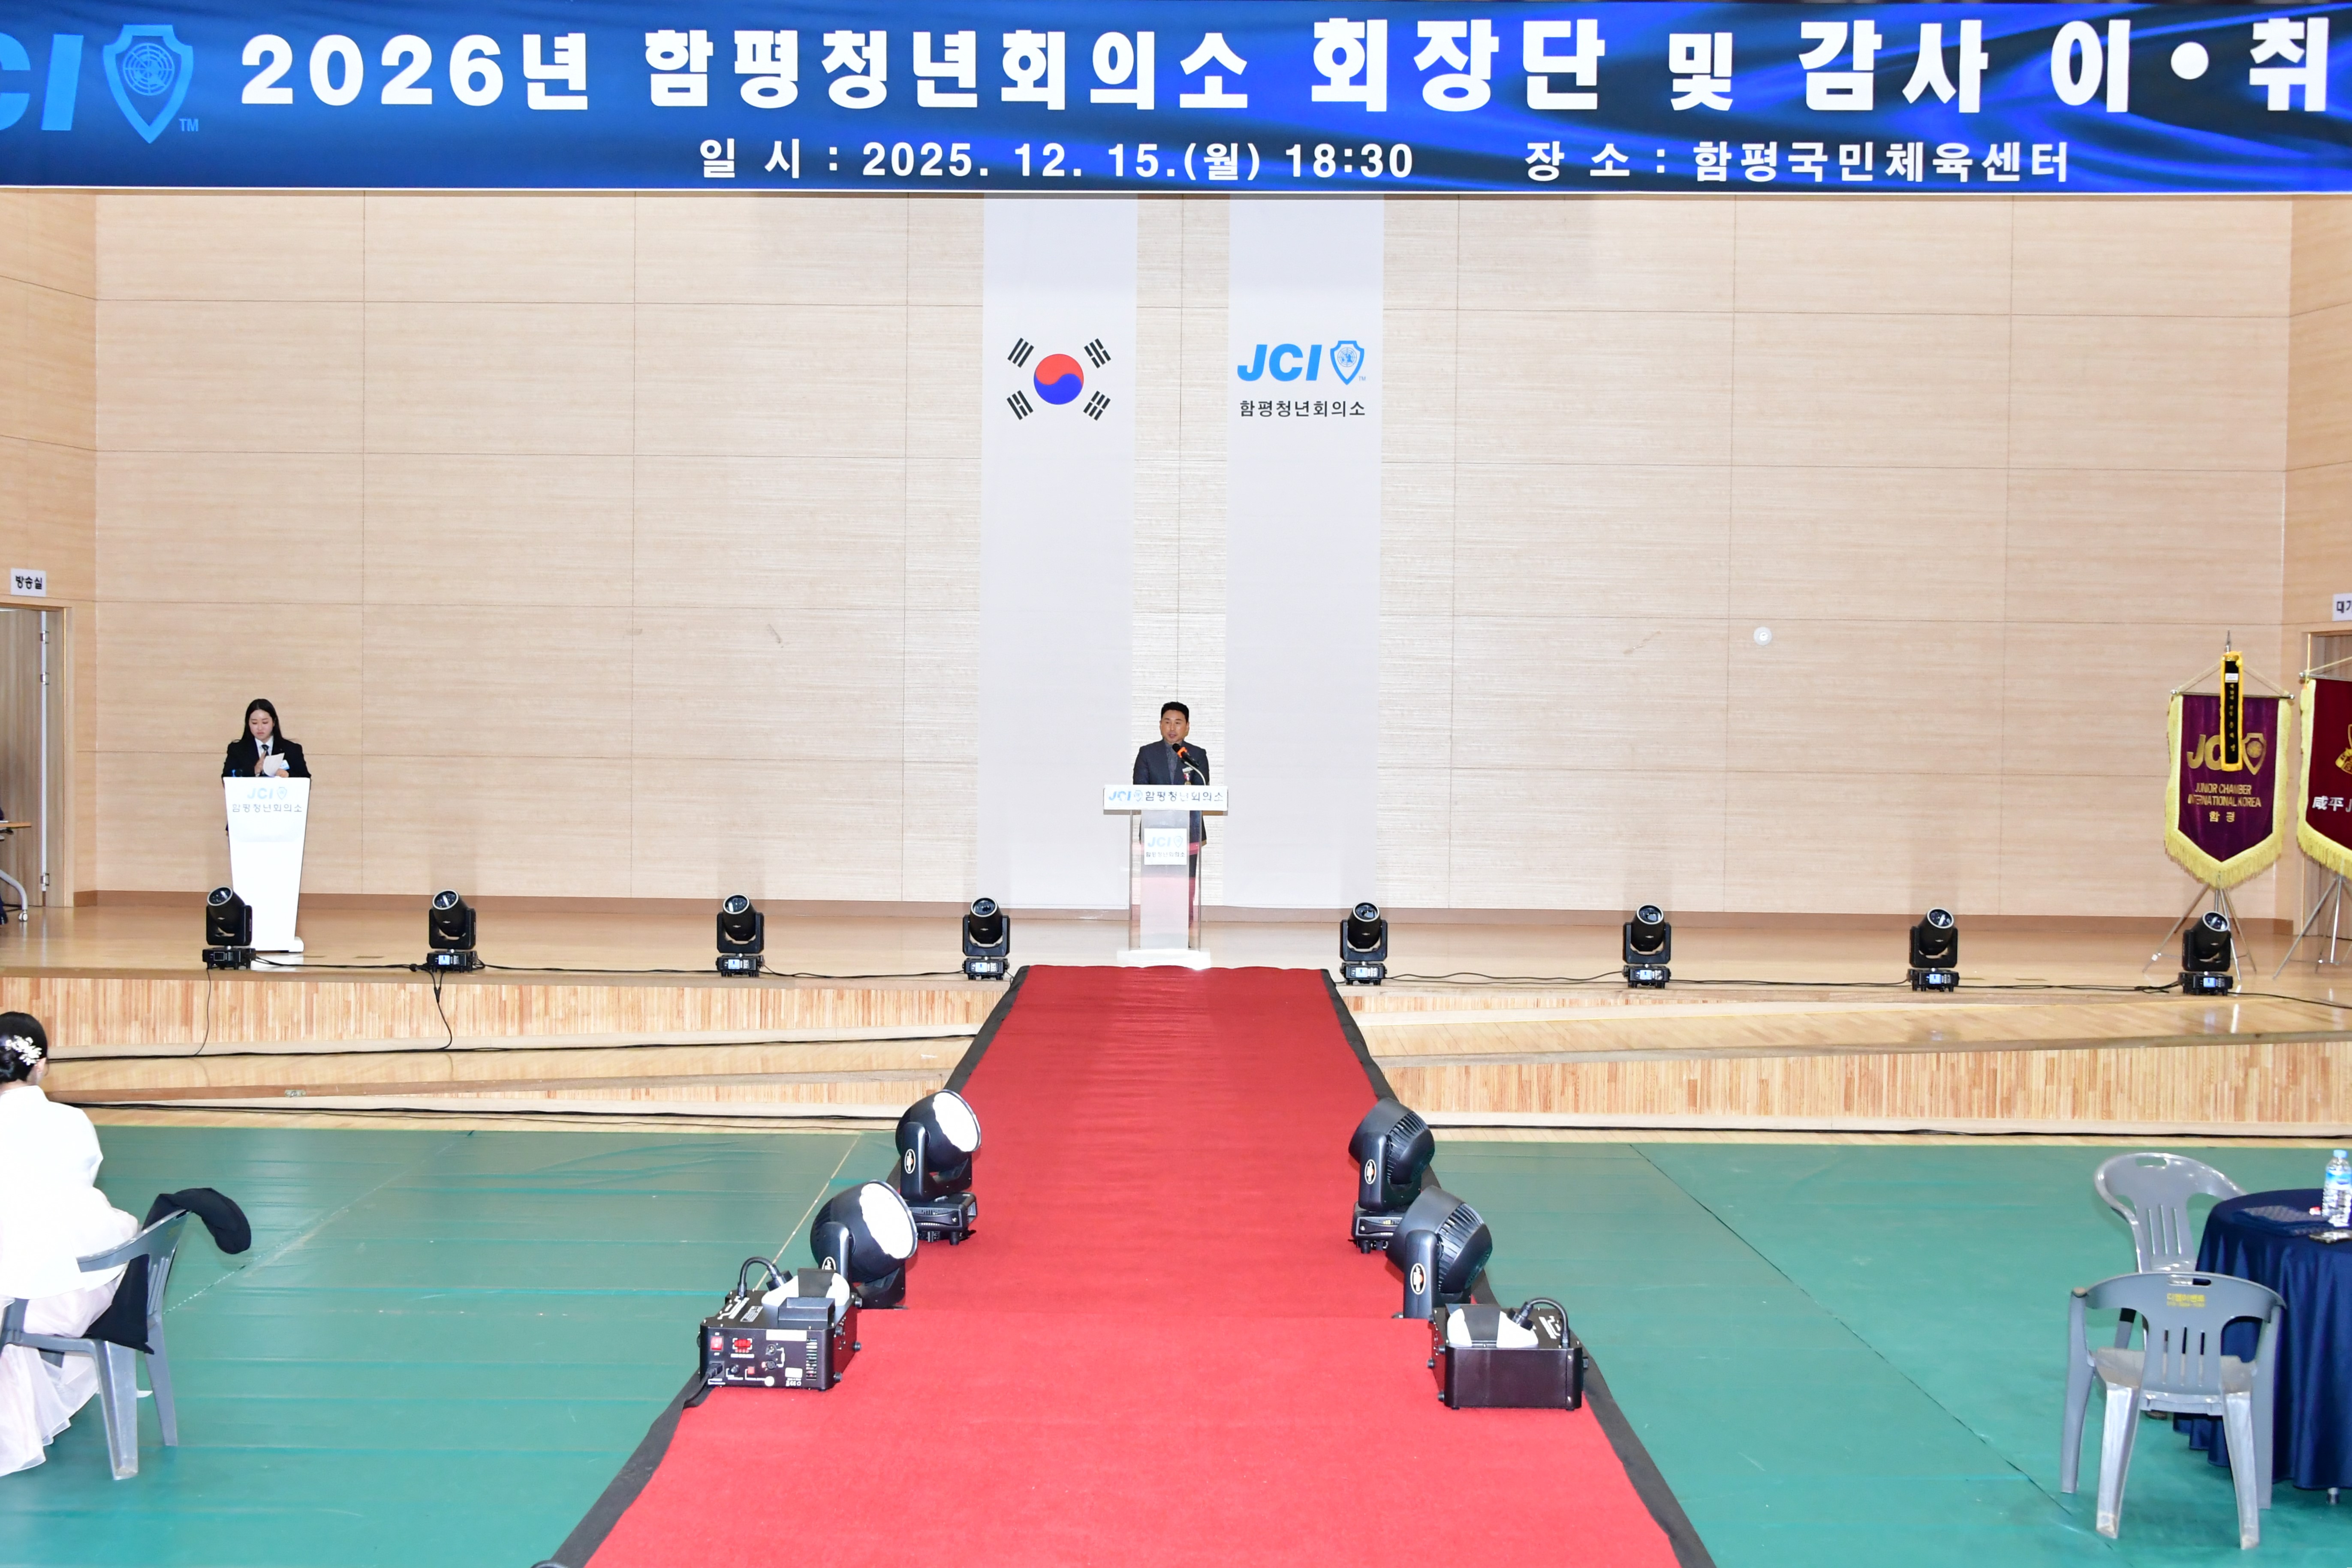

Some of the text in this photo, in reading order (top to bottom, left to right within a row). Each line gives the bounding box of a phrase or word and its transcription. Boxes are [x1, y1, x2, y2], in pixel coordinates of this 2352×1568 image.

[242, 33, 588, 110] 2026년
[645, 30, 1248, 110] 함평청년회의소
[1312, 18, 1605, 111] 회장단
[1669, 32, 1733, 111] 및
[1799, 20, 1988, 113] 감사
[179, 118, 199, 132] TM
[863, 142, 988, 177] 2025.
[1015, 143, 1081, 176] 12.
[1108, 143, 1259, 181] 15.(월)
[1286, 144, 1412, 178] 18:30
[1693, 141, 2067, 182] 함평국민체육센터
[1237, 343, 1323, 382] JCI
[1240, 400, 1365, 417] 함평청년회의소
[15, 575, 42, 590] 방송실
[2187, 734, 2220, 770] JC
[247, 787, 274, 799] JCI
[1108, 791, 1132, 801] JCI
[2195, 782, 2252, 795] JUNIOR CHAMBER
[2238, 797, 2262, 807] KOREA
[1147, 837, 1171, 847] JCI
